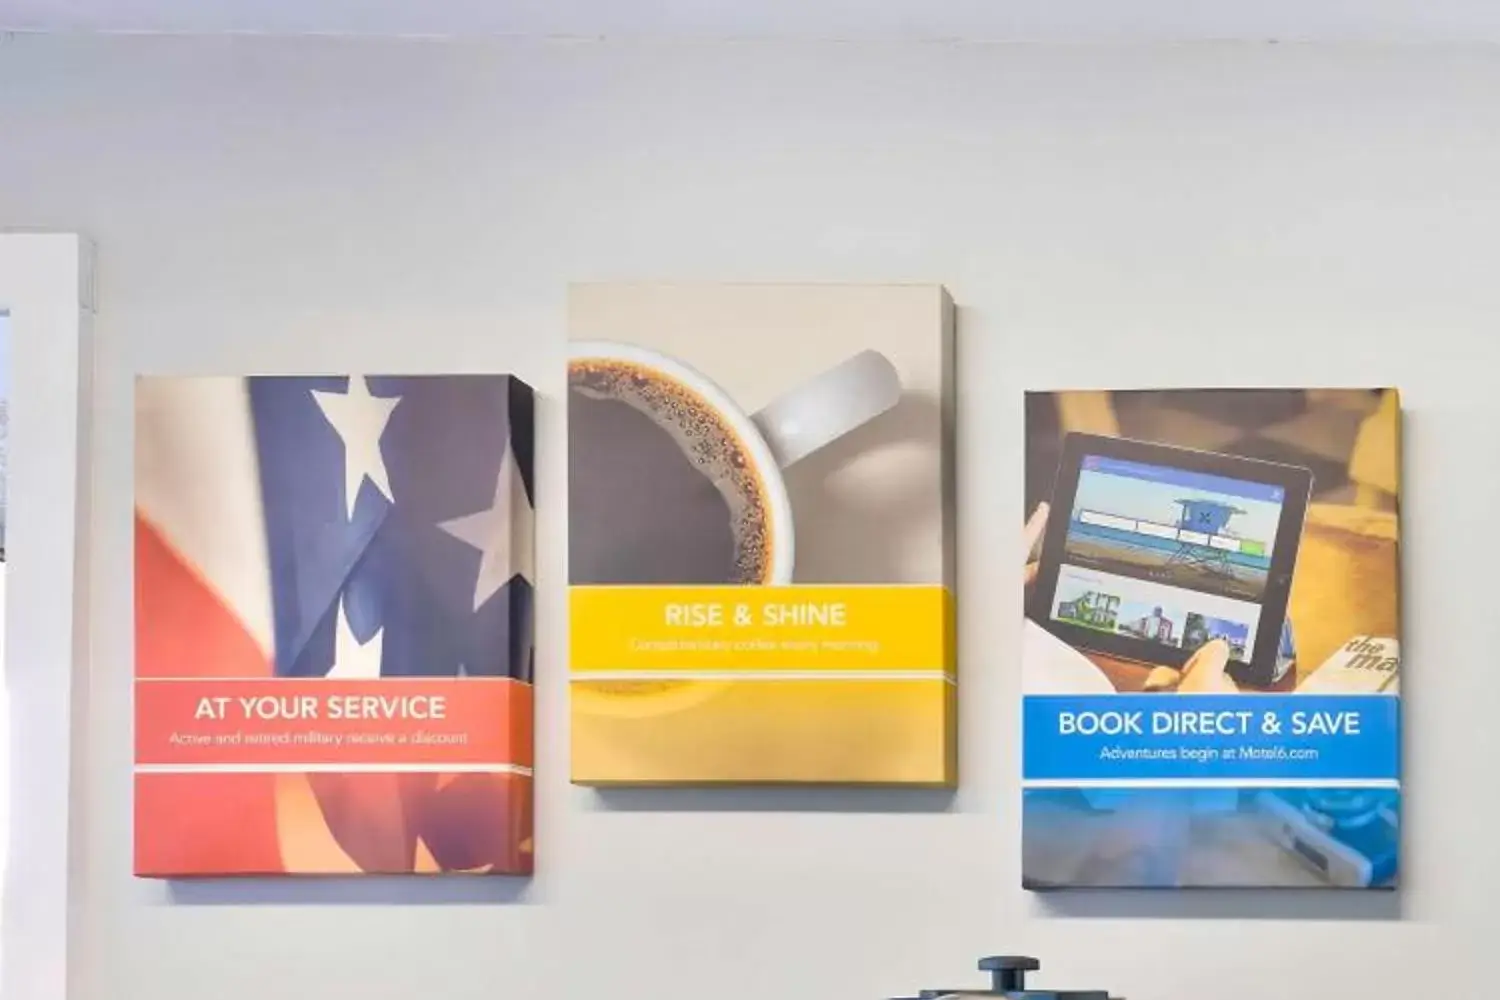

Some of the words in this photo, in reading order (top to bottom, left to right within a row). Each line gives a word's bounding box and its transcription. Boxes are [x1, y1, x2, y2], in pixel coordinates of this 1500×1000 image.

[664, 602, 724, 627] RISE
[733, 602, 753, 627] &
[763, 602, 847, 627] SHINE
[194, 696, 234, 720] AT
[239, 695, 319, 720] YOUR
[327, 694, 447, 720] SERVICE
[1058, 711, 1144, 735] BOOK
[1152, 711, 1254, 735] DIRECT
[1260, 711, 1283, 735] &
[1291, 711, 1361, 735] SAVE
[169, 731, 212, 745] Active
[217, 730, 241, 745] and
[293, 730, 343, 749] military
[1100, 745, 1177, 761] Adventures
[1181, 746, 1219, 764] begin
[1223, 748, 1236, 761] at
[1239, 745, 1319, 761] Motel6.com
